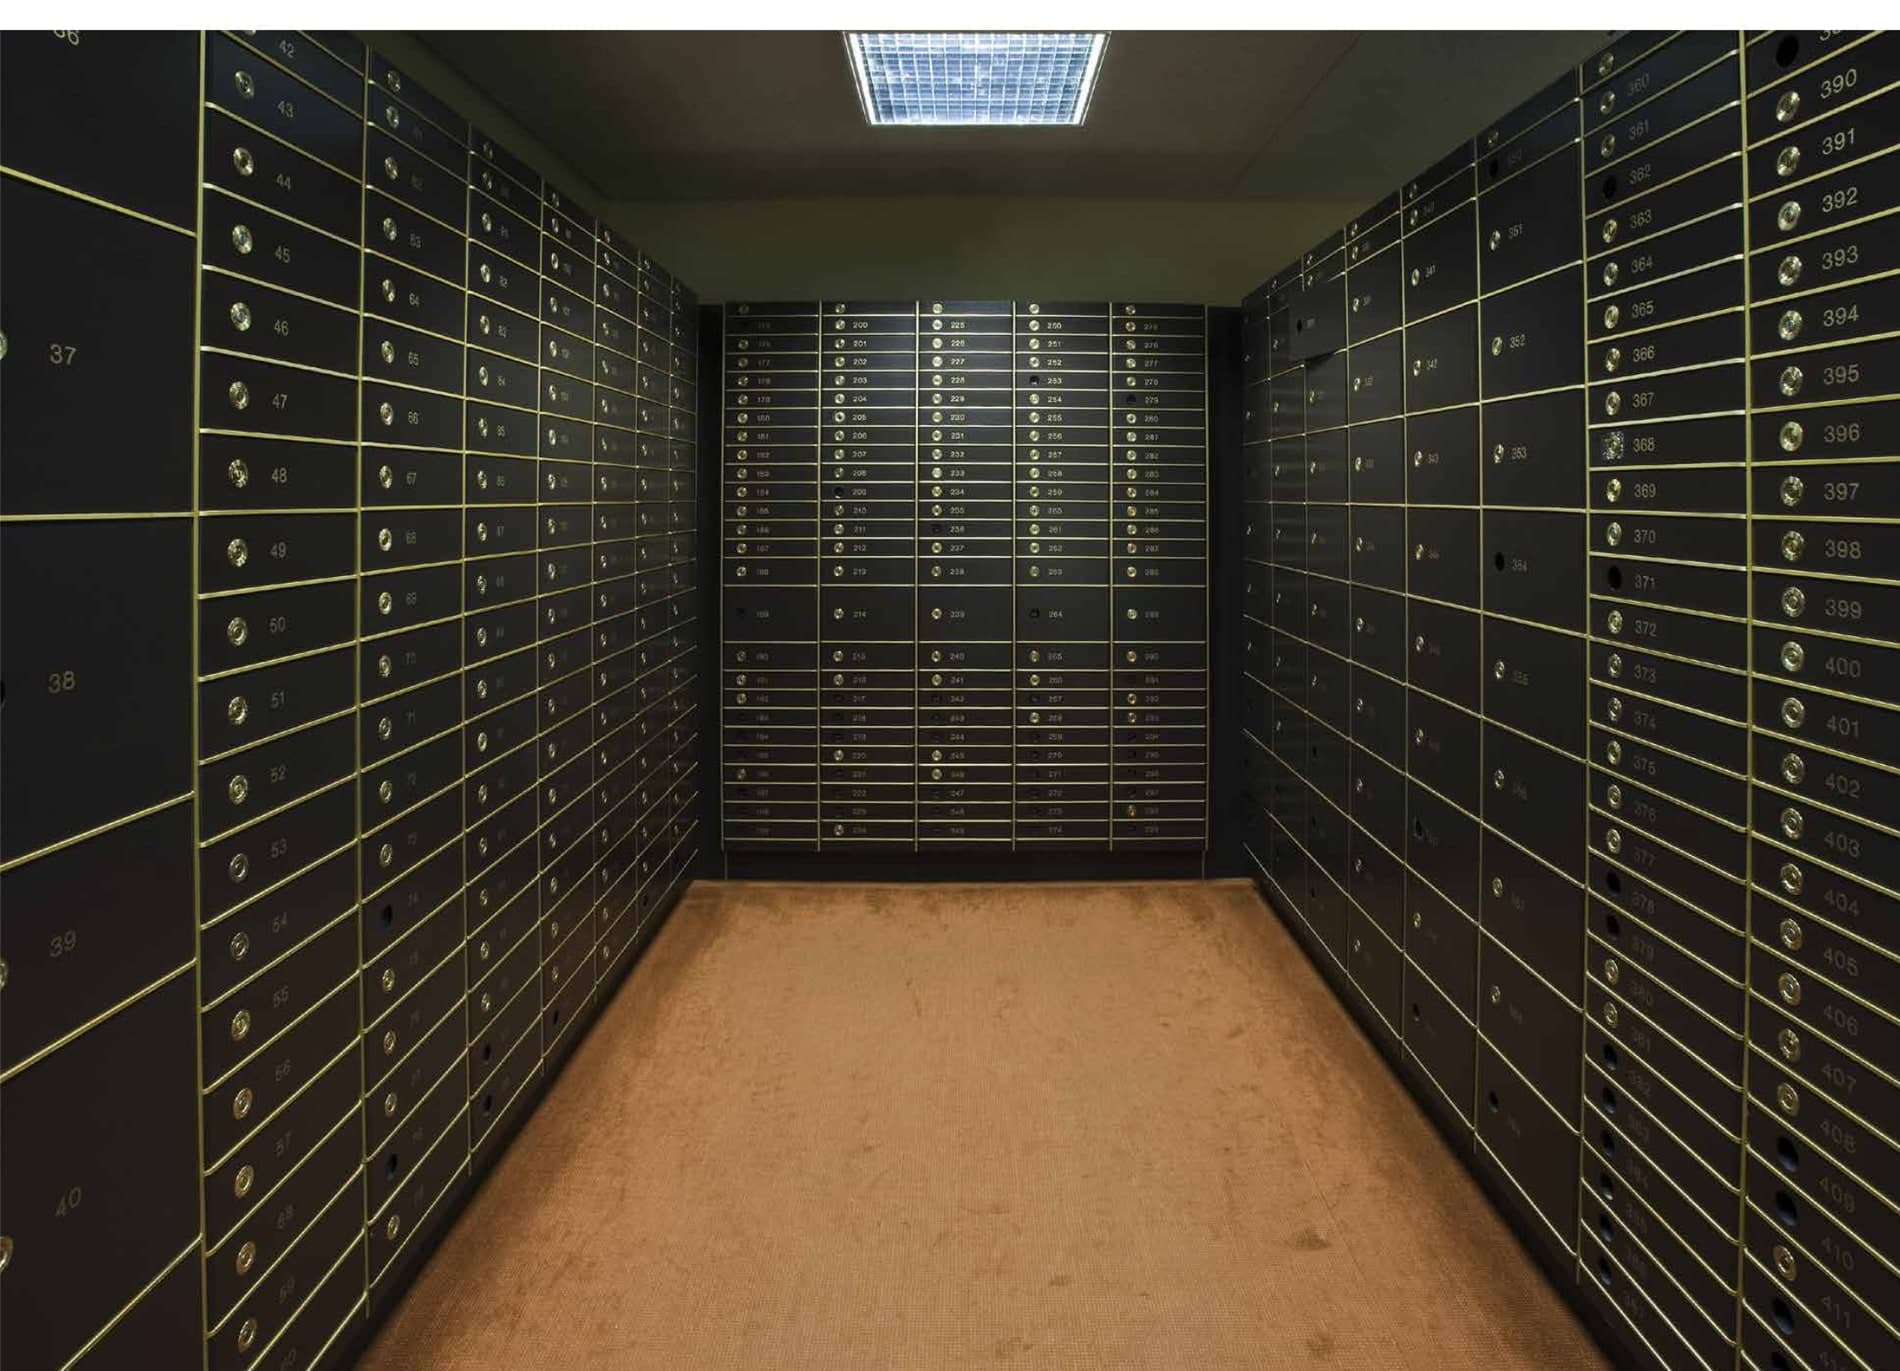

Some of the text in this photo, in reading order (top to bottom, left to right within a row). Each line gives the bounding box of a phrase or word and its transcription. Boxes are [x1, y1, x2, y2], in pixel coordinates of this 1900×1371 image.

[280, 39, 295, 58] 42
[1820, 69, 1857, 99] 390
[278, 101, 294, 119] 43
[1822, 128, 1856, 156] 391
[276, 174, 291, 190] 44
[1822, 187, 1858, 213] 392
[1630, 209, 1652, 230] 363
[1509, 224, 1524, 239] 351
[275, 246, 290, 263] 45
[1822, 245, 1858, 270] 393
[1631, 255, 1653, 274] 364
[1632, 301, 1654, 320] 365
[1823, 304, 1859, 328] 394
[274, 320, 289, 336] 46
[1510, 334, 1525, 348] 352
[49, 344, 76, 365] 37
[1633, 345, 1655, 363] 366
[1824, 363, 1859, 386] 395
[272, 394, 288, 409] 47
[1633, 392, 1655, 408] 367
[1824, 422, 1860, 443] 396
[1511, 444, 1528, 460] 353
[1633, 437, 1655, 453] 368
[272, 467, 287, 483] 48
[1634, 483, 1656, 499] 369
[1824, 482, 1860, 501] 397
[1634, 529, 1656, 544] 370
[270, 542, 286, 559] 49
[1825, 540, 1861, 560] 398
[1635, 575, 1655, 590] 371
[1825, 599, 1861, 619] 399
[270, 616, 286, 633] 50
[1634, 620, 1656, 637] 372
[1825, 657, 1861, 679] 400
[48, 671, 76, 694] 38
[272, 691, 285, 708] 51
[1826, 714, 1860, 738] 401
[271, 765, 286, 782] 52
[1825, 773, 1860, 799] 402
[1824, 831, 1860, 859] 403
[1824, 889, 1860, 916] 404
[50, 930, 76, 957] 39
[1822, 946, 1860, 979] 405
[1822, 1004, 1860, 1038] 406
[1821, 1062, 1858, 1095] 407
[1819, 1118, 1857, 1155] 408
[56, 1187, 82, 1217] 40
